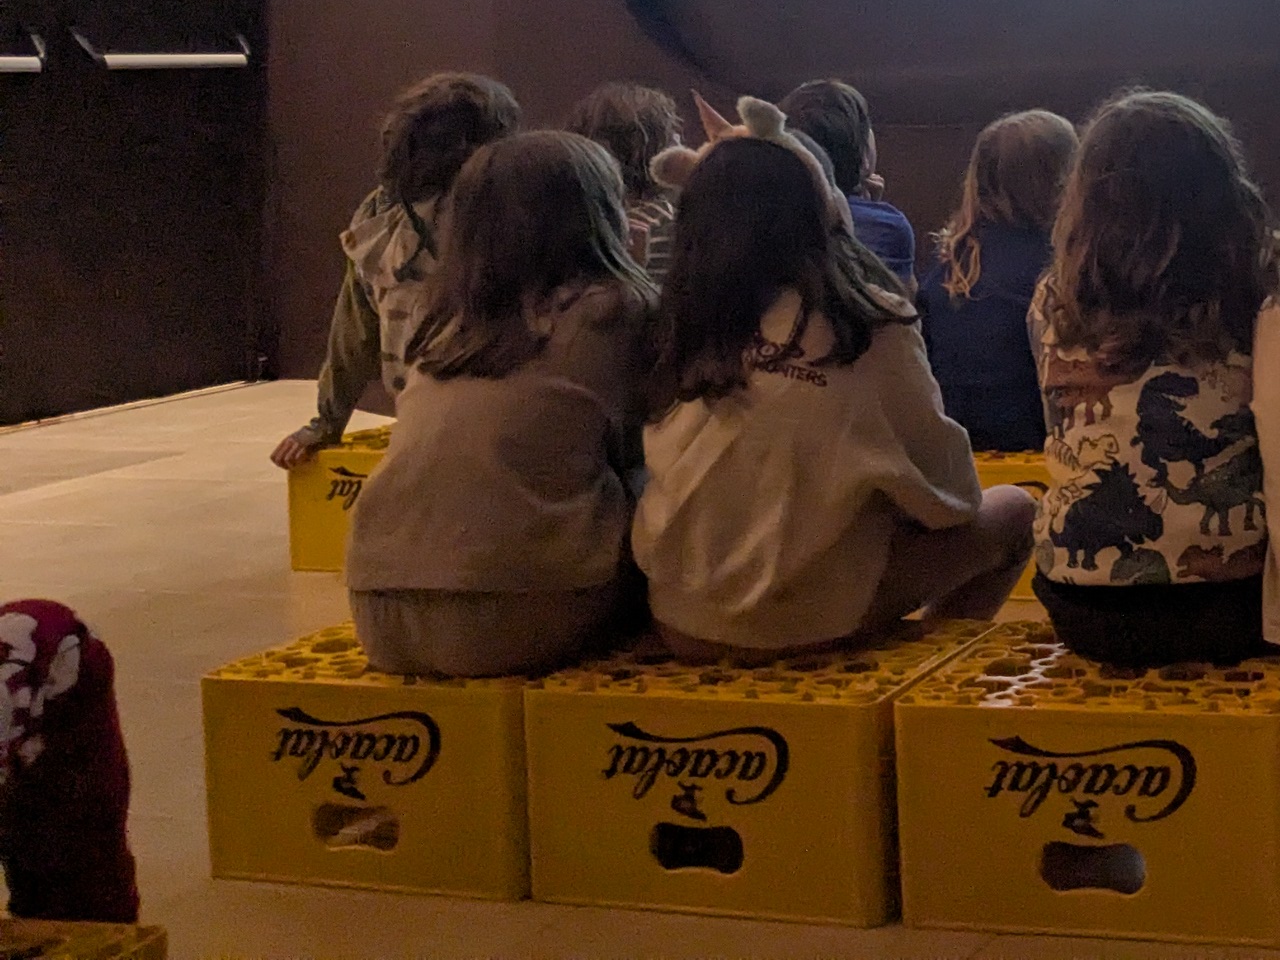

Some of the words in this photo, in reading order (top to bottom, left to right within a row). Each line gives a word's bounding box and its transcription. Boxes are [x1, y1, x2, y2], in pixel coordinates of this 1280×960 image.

[271, 707, 441, 786] Cacaolat
[603, 721, 791, 805] Cacaolat
[986, 735, 1197, 823] Cacaolat
